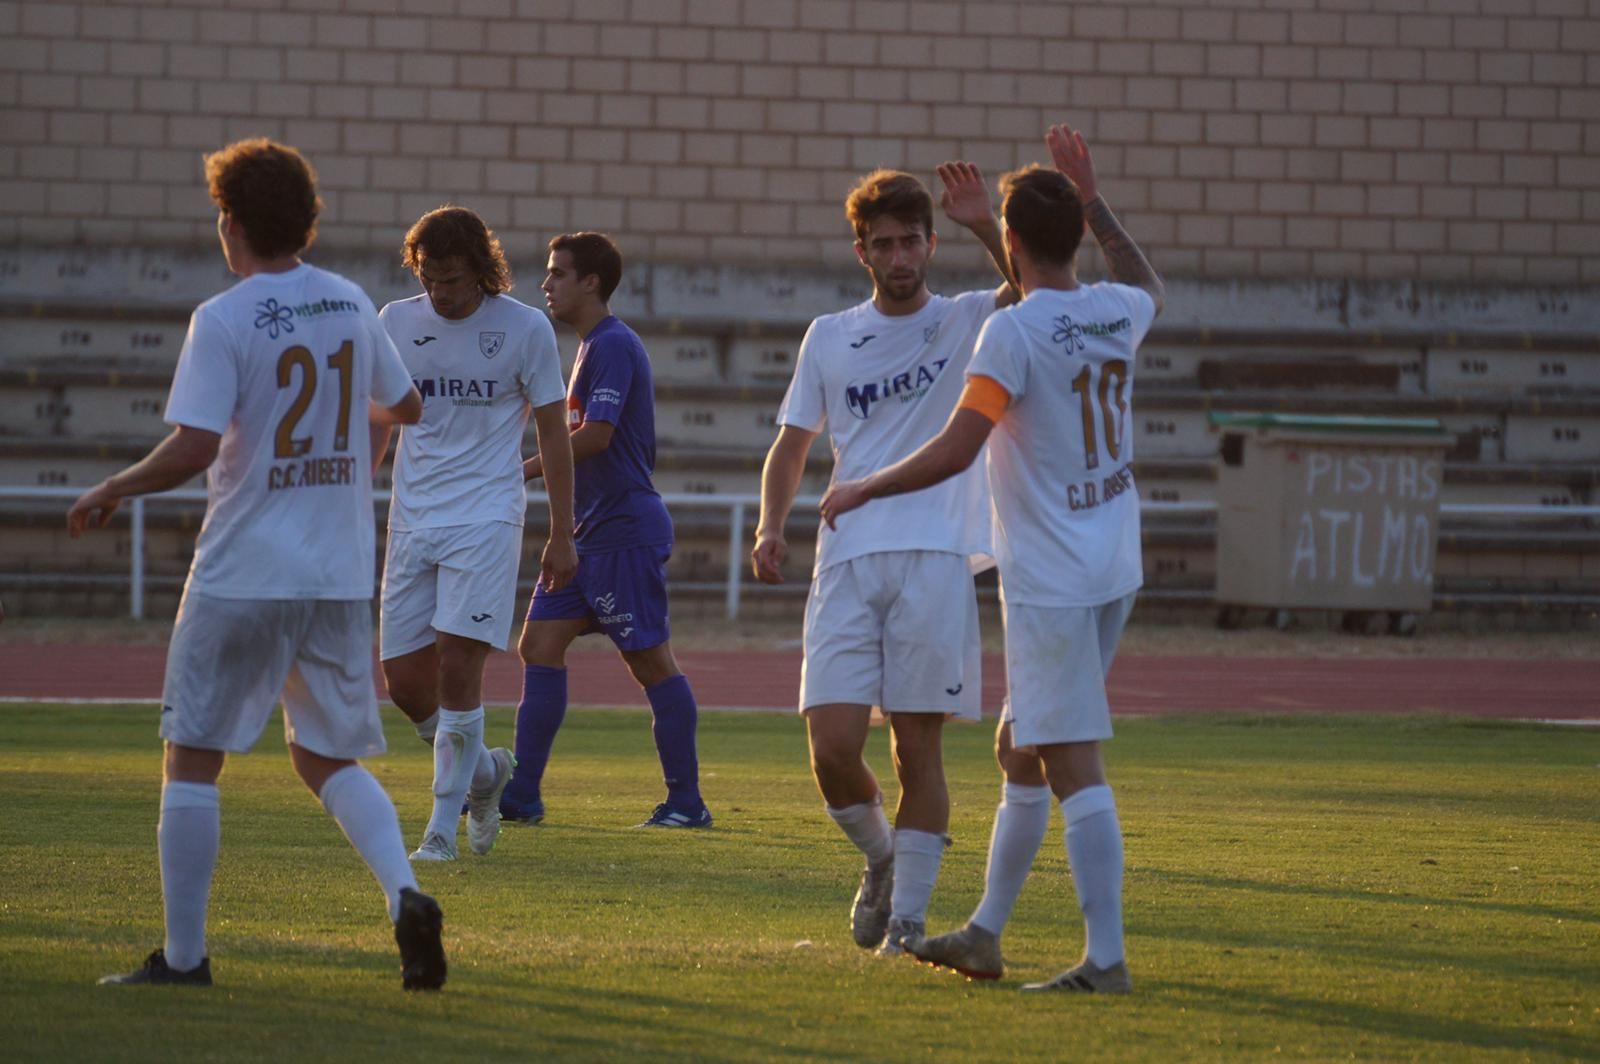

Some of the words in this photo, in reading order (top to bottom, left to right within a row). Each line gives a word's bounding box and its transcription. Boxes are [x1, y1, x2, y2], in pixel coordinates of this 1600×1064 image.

[273, 339, 355, 460] 21
[1071, 359, 1128, 471] 10
[1067, 480, 1099, 511] C.D.
[1306, 454, 1439, 500] PISTAS
